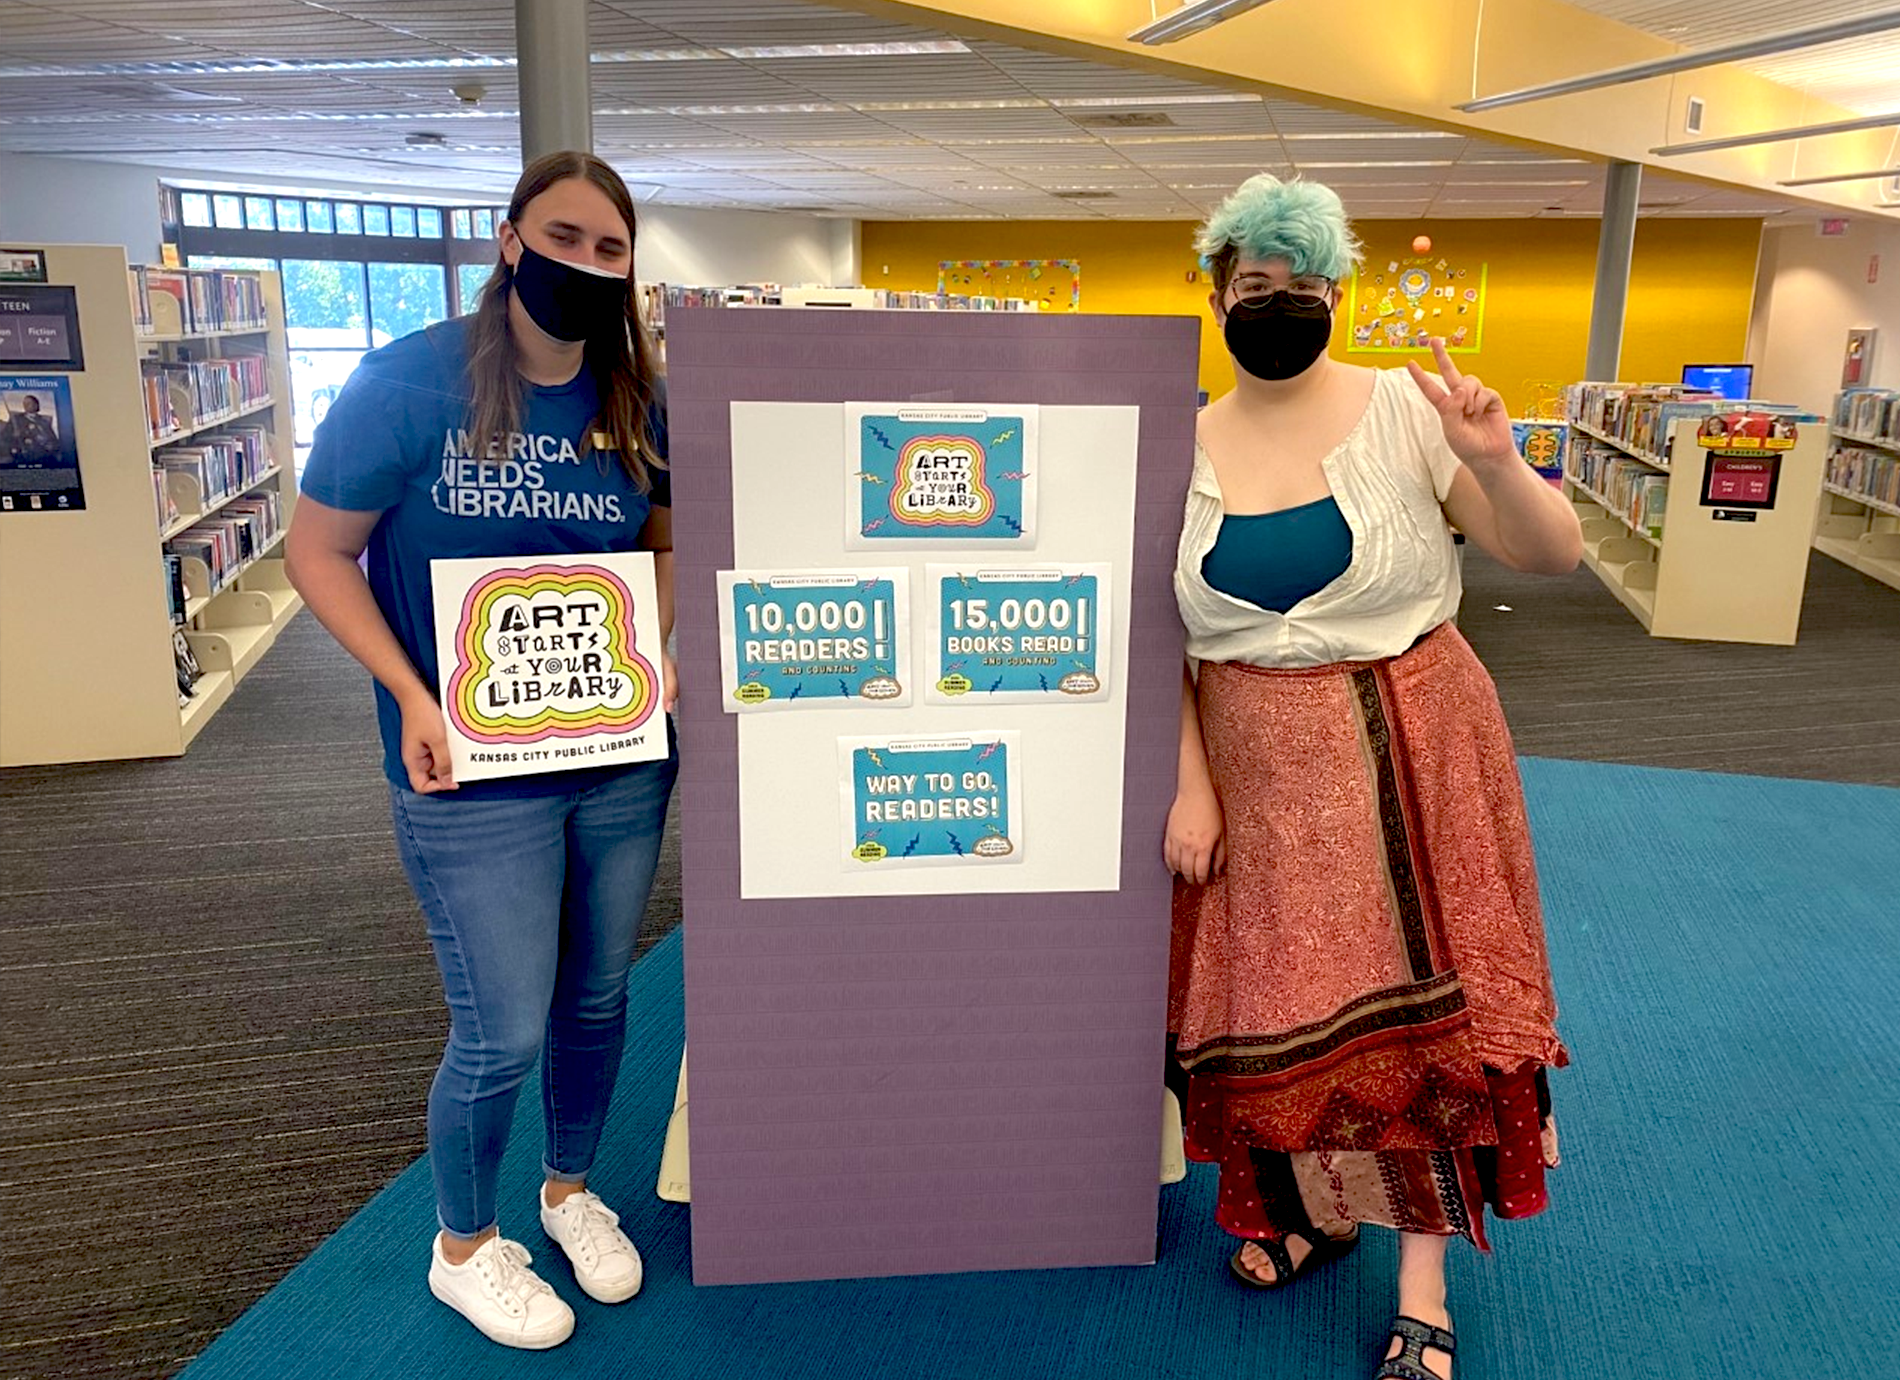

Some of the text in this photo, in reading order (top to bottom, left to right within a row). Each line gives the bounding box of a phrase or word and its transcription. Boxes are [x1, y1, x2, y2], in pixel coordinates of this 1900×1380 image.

[2, 302, 31, 311] TEEN
[28, 327, 56, 336] Fiction
[16, 378, 58, 387] Williams
[916, 455, 968, 469] ART
[442, 458, 545, 489] NEEDS
[499, 603, 600, 632] ART
[744, 637, 870, 663] READERS
[947, 636, 1073, 654] BOOKS READ
[500, 664, 519, 675] at
[982, 656, 1057, 667] AND COUNTING
[782, 665, 858, 676] AND COUNTING
[470, 735, 646, 763] KANSAS CITY PUBLIC LIBRARY
[866, 772, 998, 795] WAY TO GO,
[866, 797, 1000, 823] READERS!
